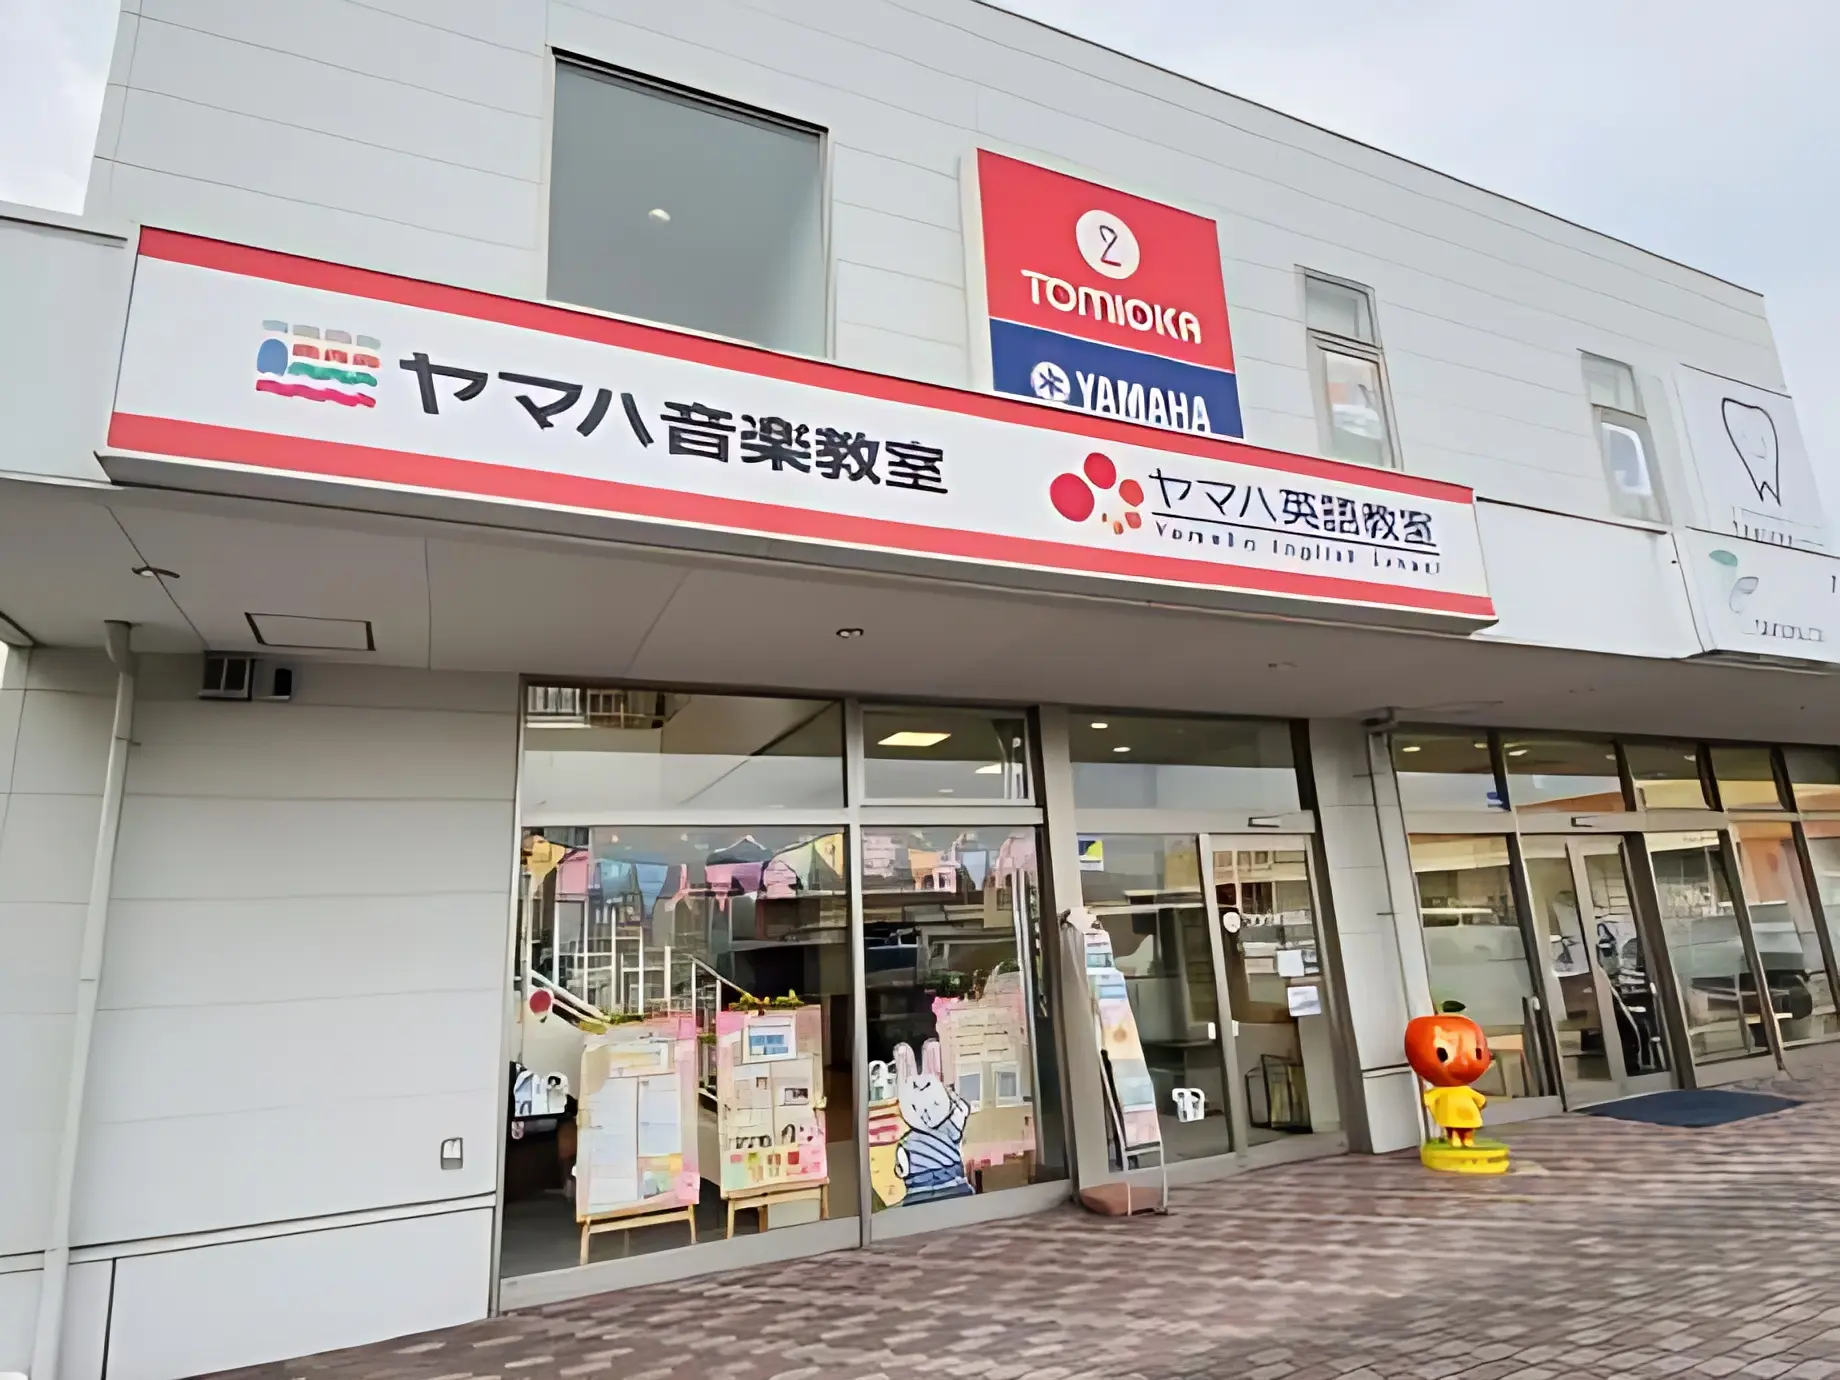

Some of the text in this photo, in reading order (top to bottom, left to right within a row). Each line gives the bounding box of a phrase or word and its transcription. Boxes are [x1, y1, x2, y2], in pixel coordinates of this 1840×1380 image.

[1020, 268, 1202, 344] TOMIOKA
[398, 351, 948, 494] ヤマハ音楽教室
[1075, 370, 1211, 434] YAMAHA
[1148, 467, 1437, 547] ヤマハ英語教室
